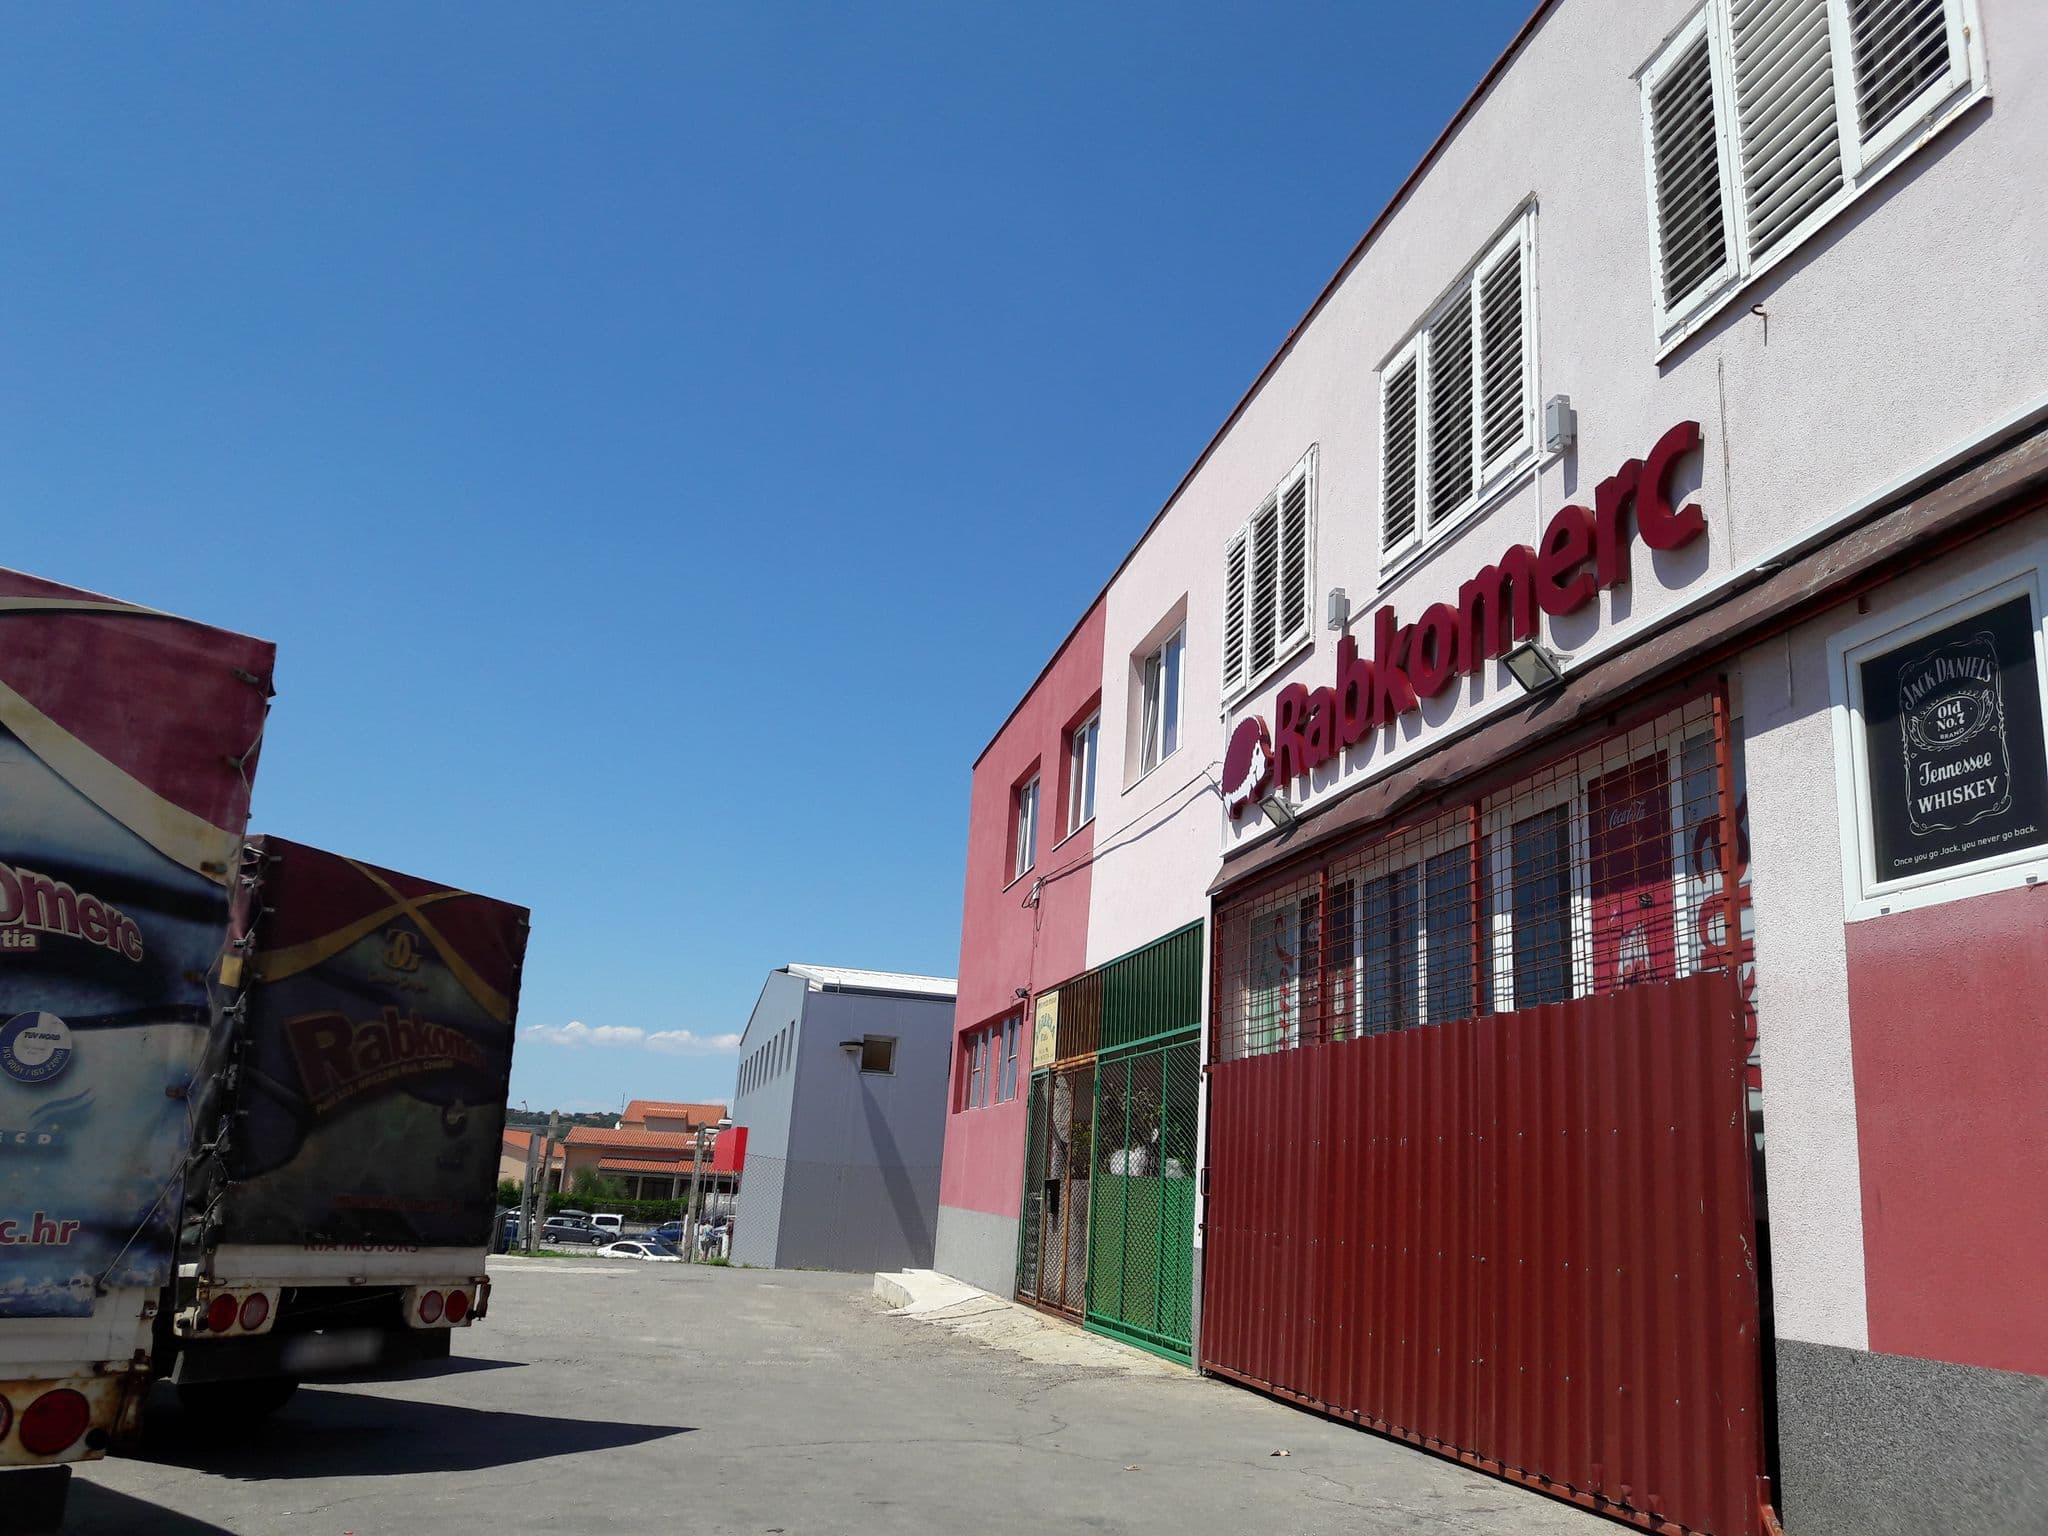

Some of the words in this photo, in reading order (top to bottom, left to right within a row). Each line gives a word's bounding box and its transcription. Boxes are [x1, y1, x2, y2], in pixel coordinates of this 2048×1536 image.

[1273, 420, 1706, 790] Rabkomerc
[1902, 670, 1936, 711] JACK
[1937, 700, 1962, 719] Old
[1939, 727, 1965, 740] BRAND
[1918, 752, 1993, 788] Tennessee
[1917, 776, 1999, 815] WHISKEY
[1893, 857, 1913, 867] Once
[1914, 853, 1928, 864] you
[1928, 850, 1939, 861] go
[1961, 840, 1976, 852] you
[1977, 834, 2001, 846] never
[2001, 830, 2013, 842] go
[2014, 824, 2038, 837] back.
[281, 1004, 488, 1104] Rabkom
